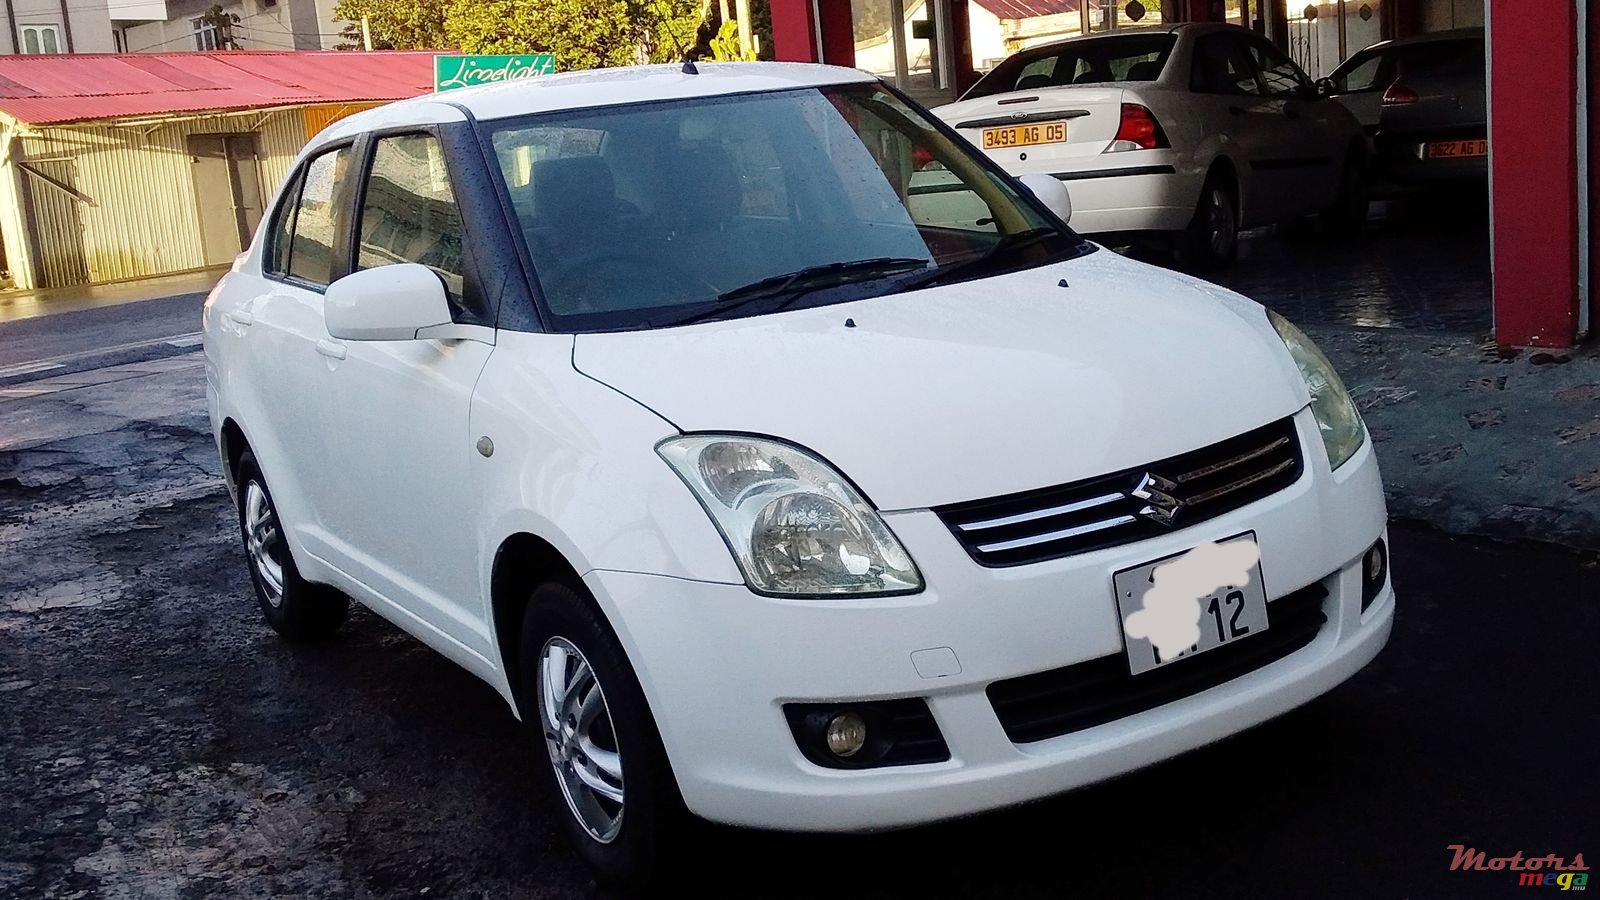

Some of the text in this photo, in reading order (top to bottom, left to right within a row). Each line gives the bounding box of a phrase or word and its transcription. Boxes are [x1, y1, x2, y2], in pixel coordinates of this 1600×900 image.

[440, 56, 552, 87] Limelight
[986, 125, 1063, 146] 3493 AG 05
[1460, 142, 1474, 155] AG
[1208, 590, 1250, 642] 12
